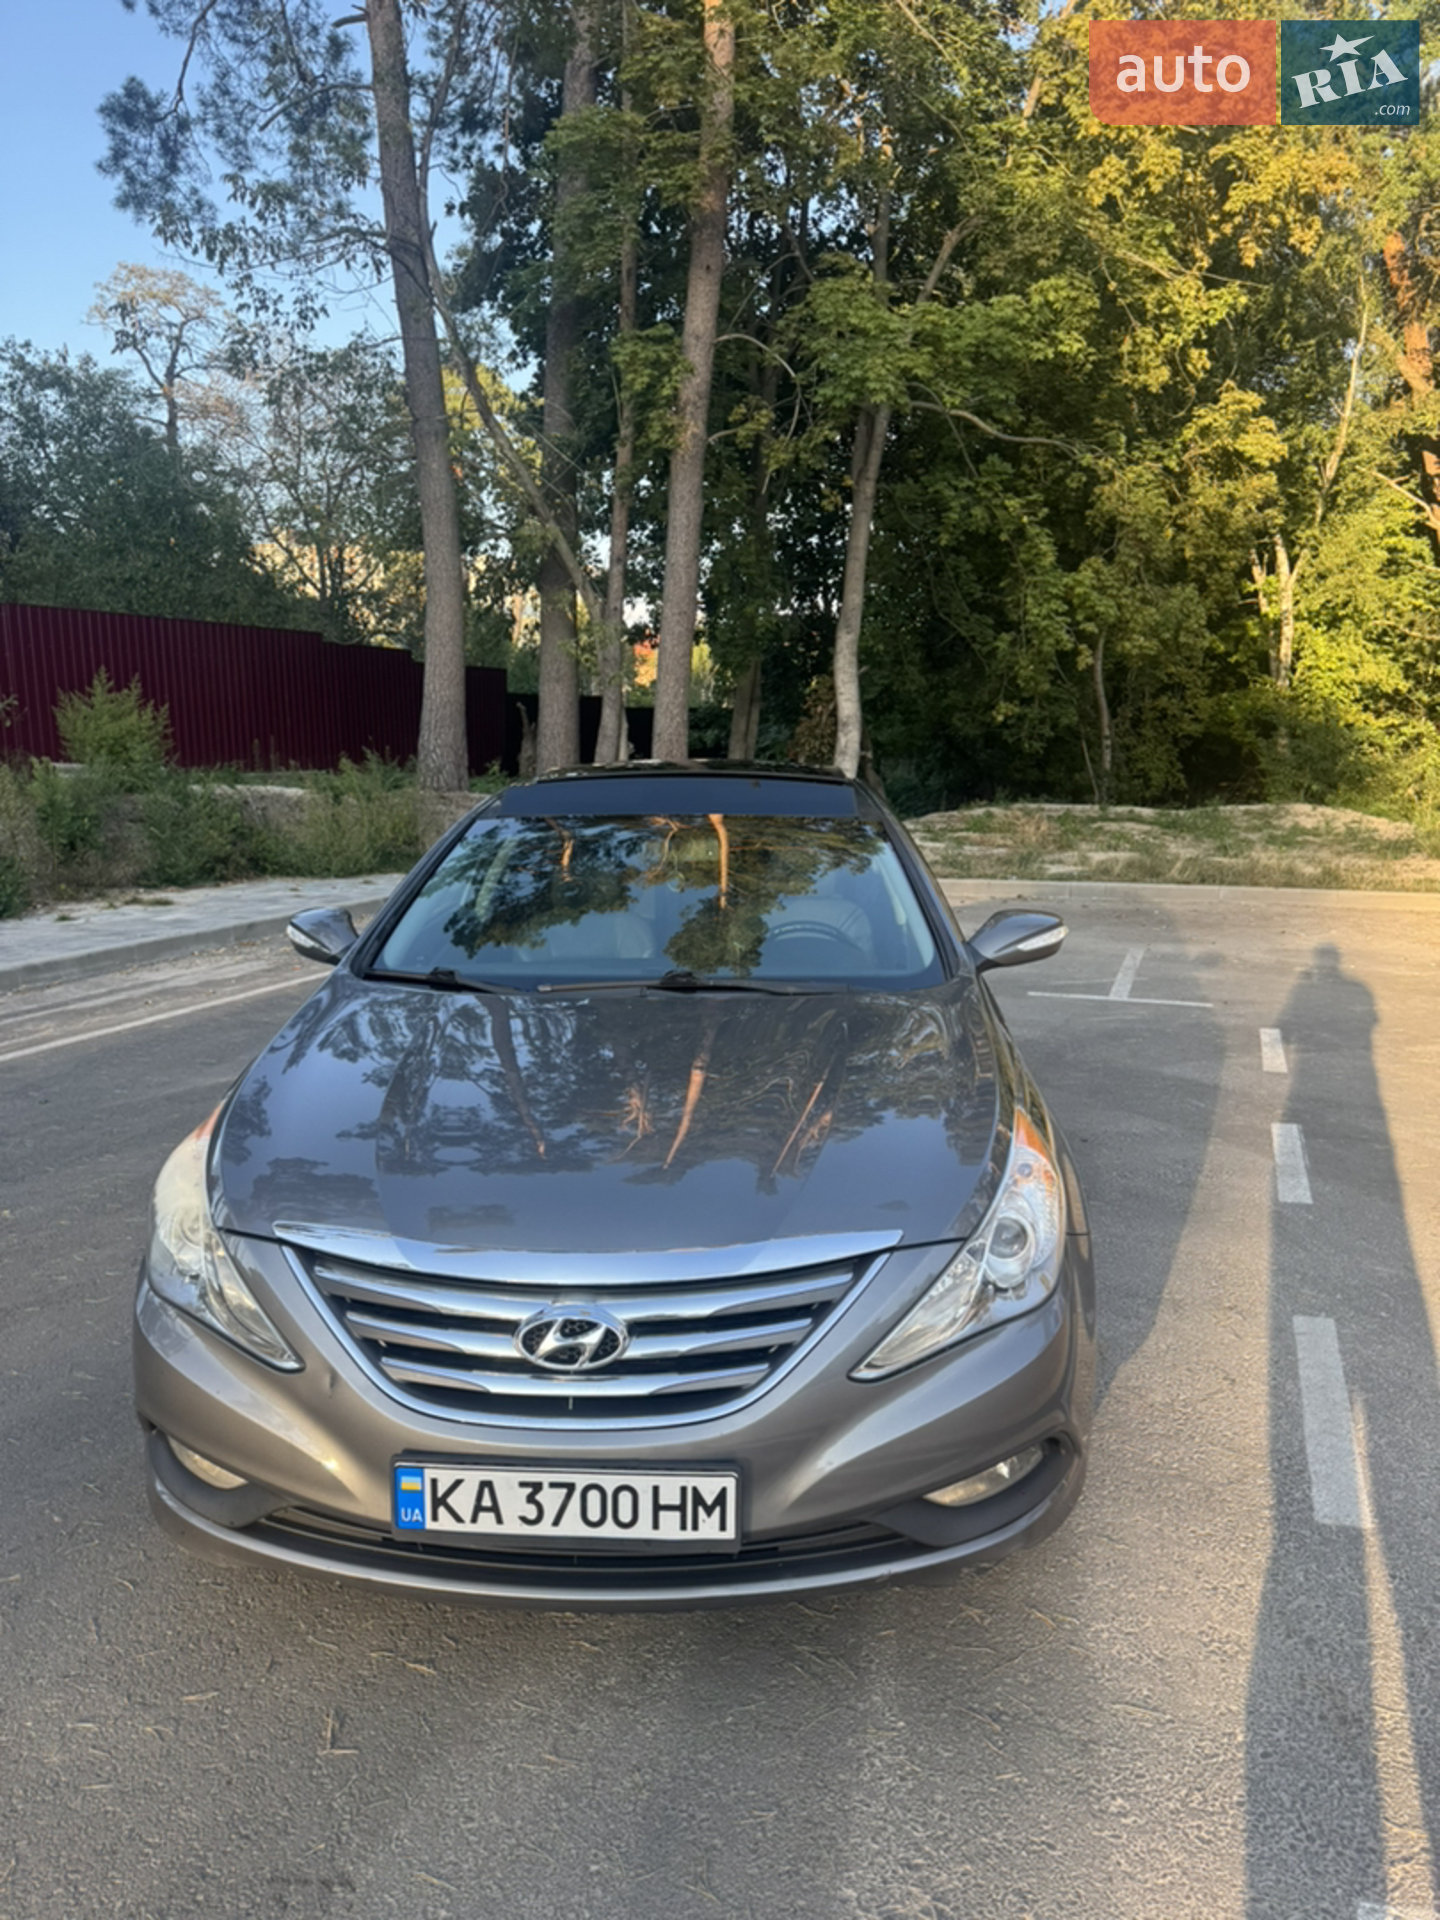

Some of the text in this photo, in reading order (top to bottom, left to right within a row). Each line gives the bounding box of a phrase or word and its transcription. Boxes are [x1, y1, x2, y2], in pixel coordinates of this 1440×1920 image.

[400, 1507, 423, 1523] UA
[429, 1477, 728, 1532] KA 3700 HM
